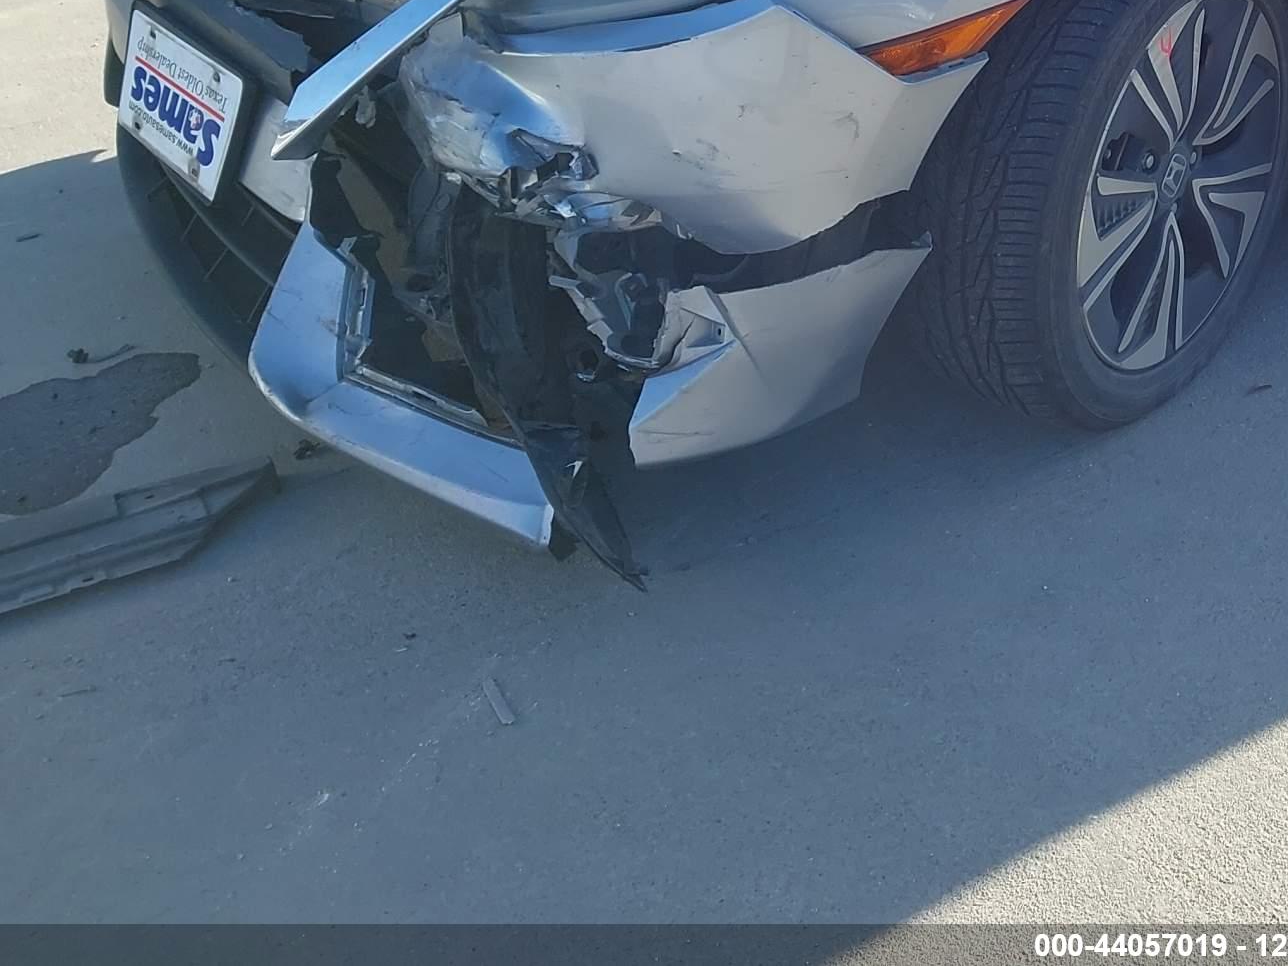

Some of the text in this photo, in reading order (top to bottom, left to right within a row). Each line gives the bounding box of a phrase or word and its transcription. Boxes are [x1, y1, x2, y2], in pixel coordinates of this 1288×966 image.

[177, 66, 204, 97] Oldest
[128, 101, 194, 156] www.samesauto.com
[130, 65, 222, 167] Sames
